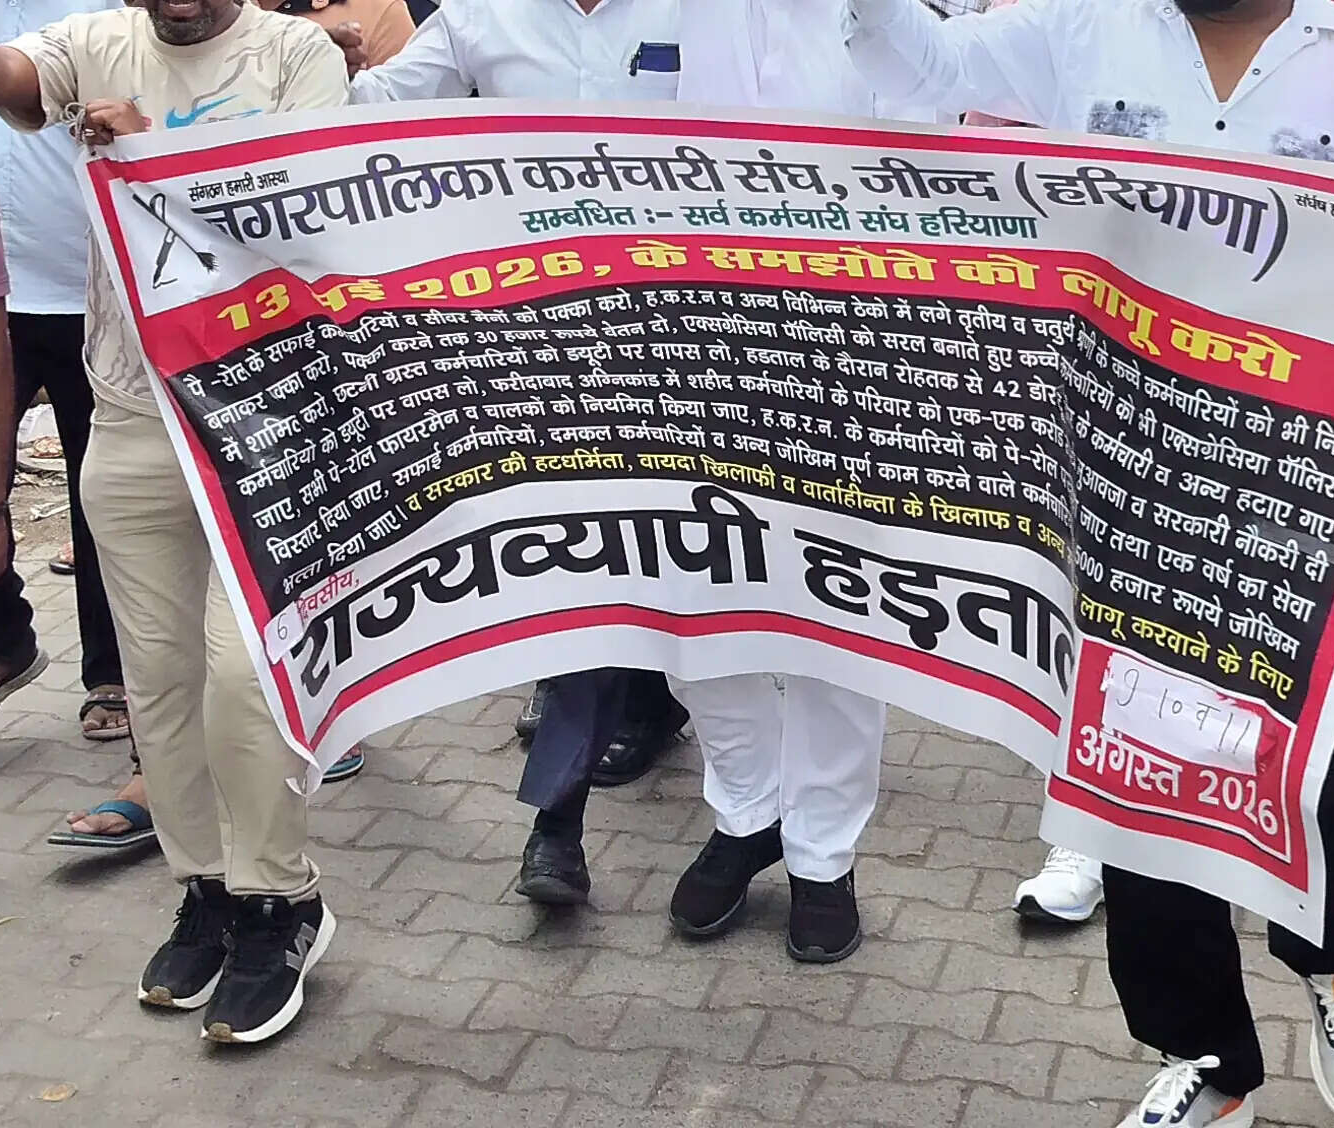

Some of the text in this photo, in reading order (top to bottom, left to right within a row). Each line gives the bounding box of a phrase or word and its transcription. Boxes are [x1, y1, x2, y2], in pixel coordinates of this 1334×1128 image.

[188, 181, 224, 202] संगठन
[225, 172, 253, 197] हमारी
[514, 142, 725, 192] कर्मचारी
[727, 149, 848, 200] संघ,
[851, 156, 1000, 201] जीन्द
[680, 199, 727, 226] सर्व
[735, 200, 851, 231] कर्मचारी
[856, 205, 910, 233] संघ
[915, 207, 1038, 239] हरियाणा
[216, 283, 290, 330] 13
[404, 251, 611, 300] 2026,
[625, 239, 687, 269] के
[950, 254, 1040, 290] को
[1056, 266, 1160, 356] लागू
[1171, 319, 1301, 383] करो
[245, 348, 264, 372] के
[265, 322, 315, 362] सफाई
[421, 309, 469, 324] सीवर
[513, 306, 539, 323] को
[542, 299, 592, 321] पक्का
[595, 288, 632, 312] करो,
[719, 292, 733, 306] व
[739, 293, 779, 310] अन्य
[783, 290, 847, 316] विभिन्न
[851, 296, 888, 319] ठेको
[893, 298, 911, 320] में
[917, 300, 951, 324] लगे
[955, 304, 1006, 334] तृतीय
[1011, 317, 1025, 334] व
[1145, 376, 1239, 428] कर्मचारियों
[1246, 406, 1275, 436] को
[1281, 415, 1310, 444] भी
[203, 392, 267, 429] बनाकर
[302, 350, 338, 380] करो,
[388, 331, 433, 352] करने
[435, 332, 469, 346] तक
[474, 331, 497, 343] 30
[500, 330, 549, 342] हजार
[601, 321, 645, 337] वेतन
[649, 313, 677, 334] दो,
[680, 312, 777, 337] एक्सग्रेसिया
[781, 320, 845, 344] पॉलिसी
[850, 324, 875, 346] को
[879, 332, 925, 353] सरल
[930, 335, 979, 361] बनाते
[985, 345, 1012, 372] हुए
[1017, 344, 1059, 370] कच्चे
[1116, 394, 1135, 424] को
[1163, 423, 1271, 474] एक्सग्रेसिया
[221, 436, 243, 461] में
[299, 392, 335, 423] करो,
[382, 361, 427, 384] ग्रस्त
[431, 346, 528, 372] कर्मचारियों
[533, 344, 559, 362] को
[617, 344, 645, 360] पर
[649, 344, 701, 360] वापस
[705, 339, 739, 365] लो,
[810, 349, 830, 371] के
[835, 351, 888, 380] दौरान
[893, 358, 958, 390] रोहतक
[964, 368, 983, 394] से
[993, 381, 1021, 398] 42
[1091, 427, 1153, 478] कर्मचारी
[1179, 472, 1231, 503] अन्य
[1237, 488, 1293, 526] हटाए
[266, 423, 1015, 564] विस्तार दिया सफाई कर्मचारियों, दमकल जोखिम पूर्ण काम करने वाले
[278, 612, 288, 640] 6
[289, 484, 770, 699] राज्यव्यापी
[423, 451, 1294, 700] सरकार की वायदा खिलाफी खिलाफ लागू करवाने के लिए
[1197, 768, 1280, 837] 2026
